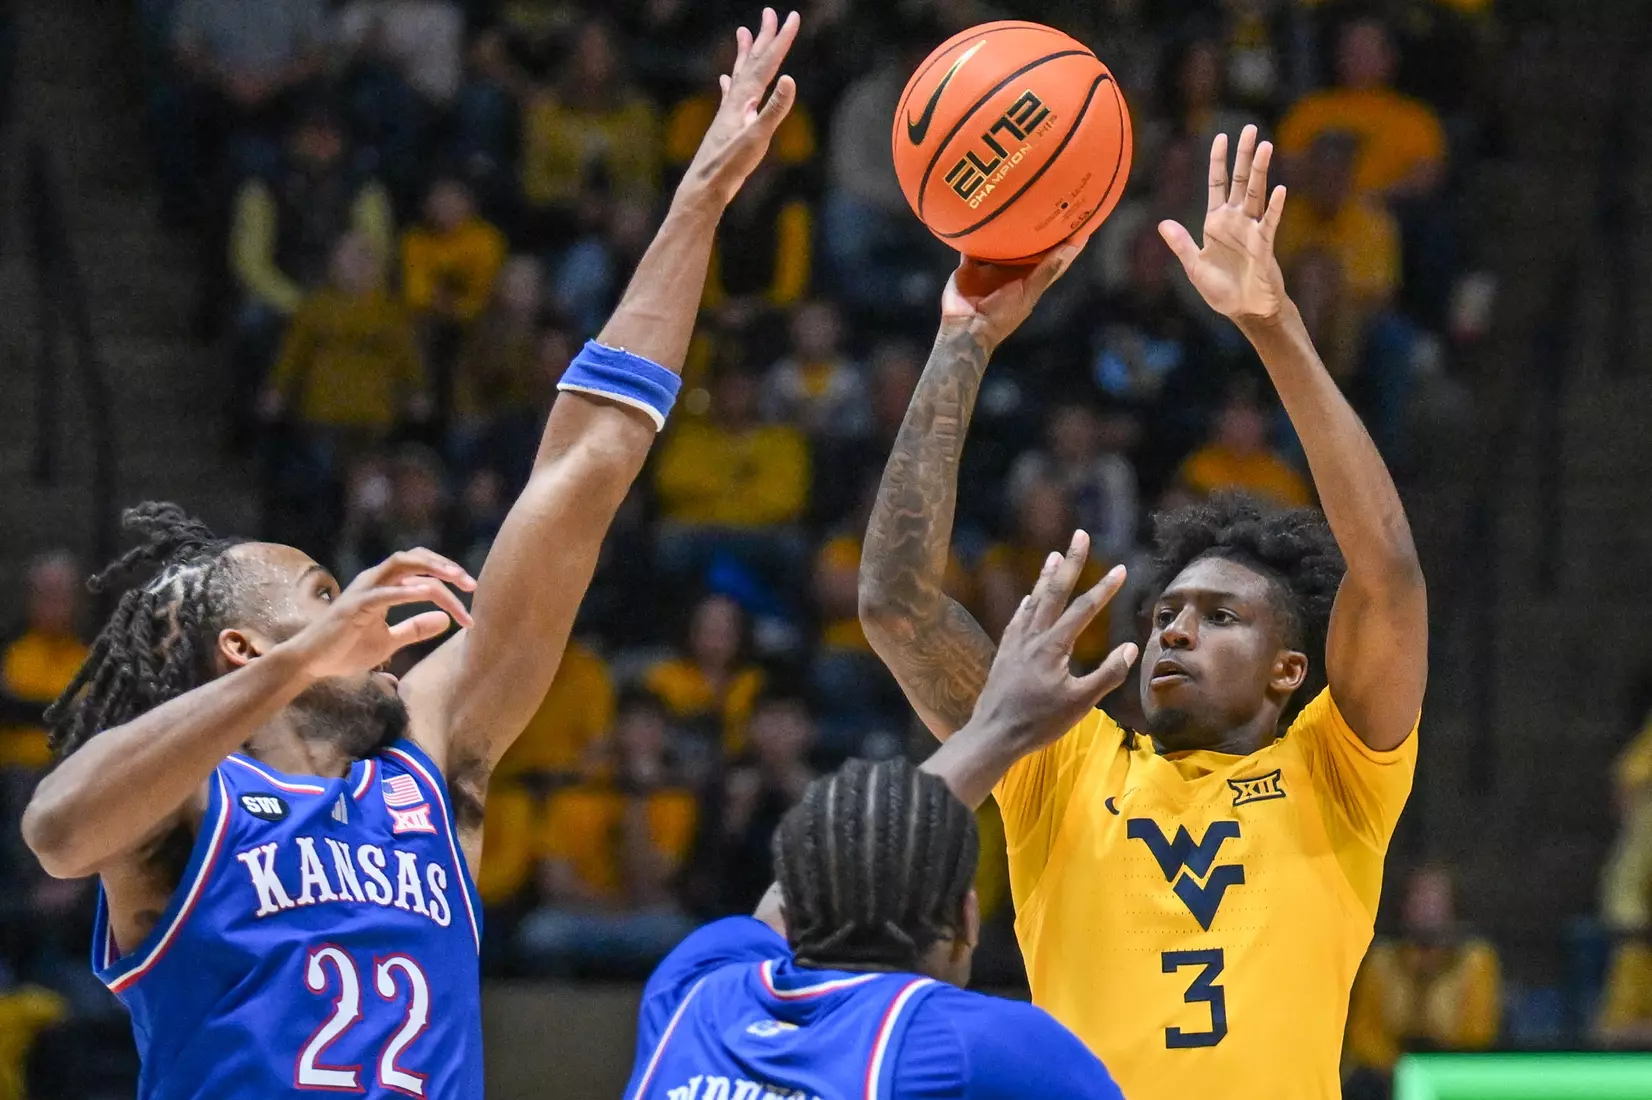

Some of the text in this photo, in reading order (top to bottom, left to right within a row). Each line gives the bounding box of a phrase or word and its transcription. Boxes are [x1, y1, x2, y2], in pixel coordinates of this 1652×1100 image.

[944, 89, 1050, 202] ELITE
[969, 143, 1032, 210] CHAMPION
[241, 796, 283, 814] SW
[1228, 769, 1286, 806] XII
[236, 836, 451, 927] KANSAS
[295, 943, 430, 1099] 22
[1161, 948, 1228, 1049] 3
